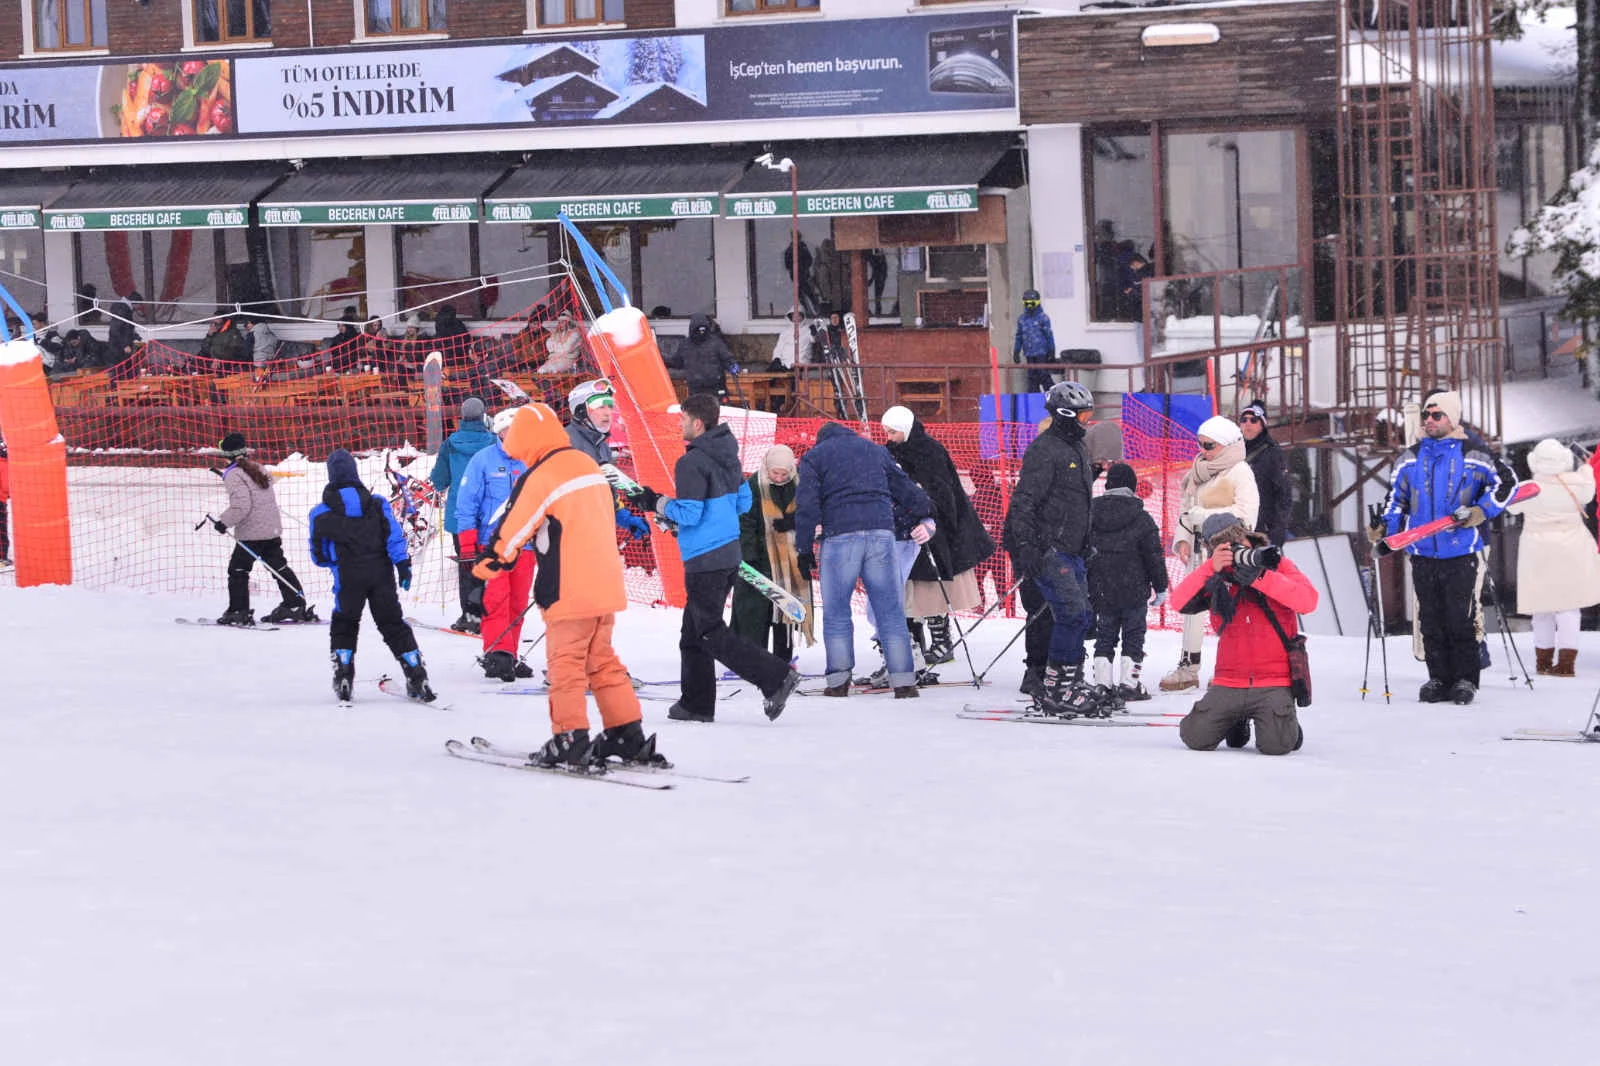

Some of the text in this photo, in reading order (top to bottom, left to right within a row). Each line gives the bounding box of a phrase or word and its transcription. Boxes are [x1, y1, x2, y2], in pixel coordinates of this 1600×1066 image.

[281, 62, 422, 83] TÜM OTELLERDE
[787, 60, 833, 74] hemen
[835, 57, 903, 73] başvurun.
[282, 81, 455, 119] %5 İNDİRİM
[0, 98, 56, 129] RİM
[613, 201, 642, 215] CAFE
[807, 195, 895, 211] BECEREN CAFE
[110, 212, 182, 227] BECEREN CAFE
[328, 207, 405, 221] BECEREN CAFE
